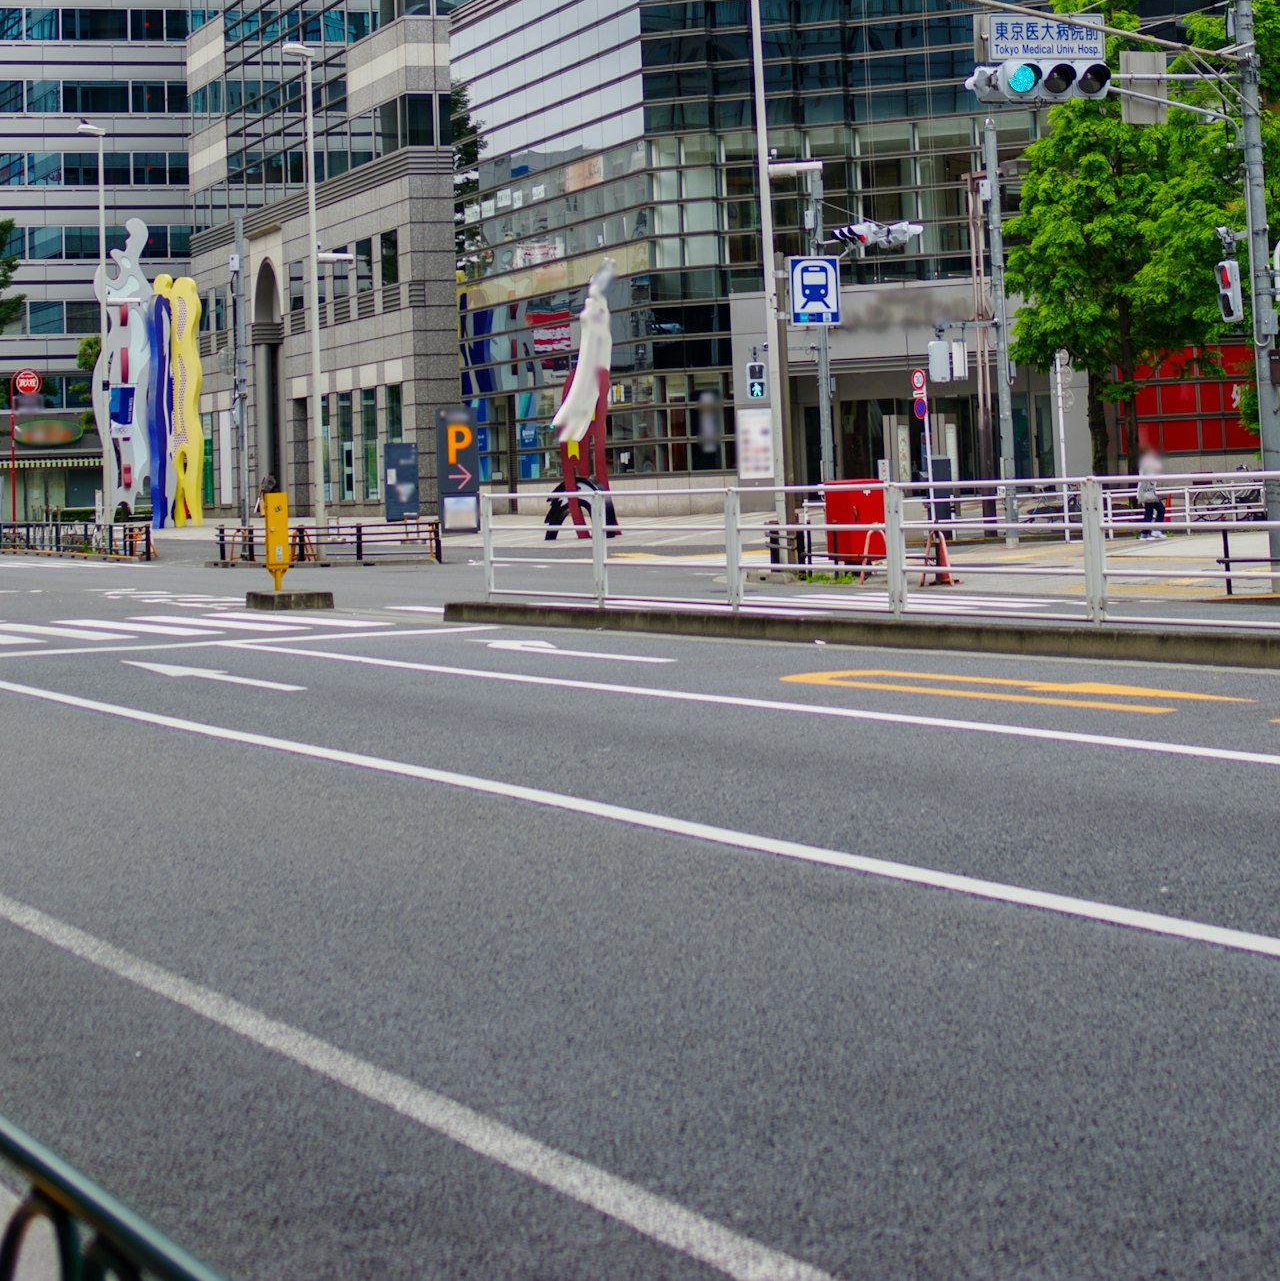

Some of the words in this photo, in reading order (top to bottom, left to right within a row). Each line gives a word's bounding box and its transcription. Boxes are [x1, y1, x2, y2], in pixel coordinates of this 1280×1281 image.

[994, 21, 1098, 41] 東京医大病院前
[994, 44, 1019, 56] Tokyo
[1022, 44, 1054, 55] Medical
[1056, 44, 1077, 55] Univ.
[1077, 44, 1101, 56] Hosp.
[447, 423, 473, 465] P
